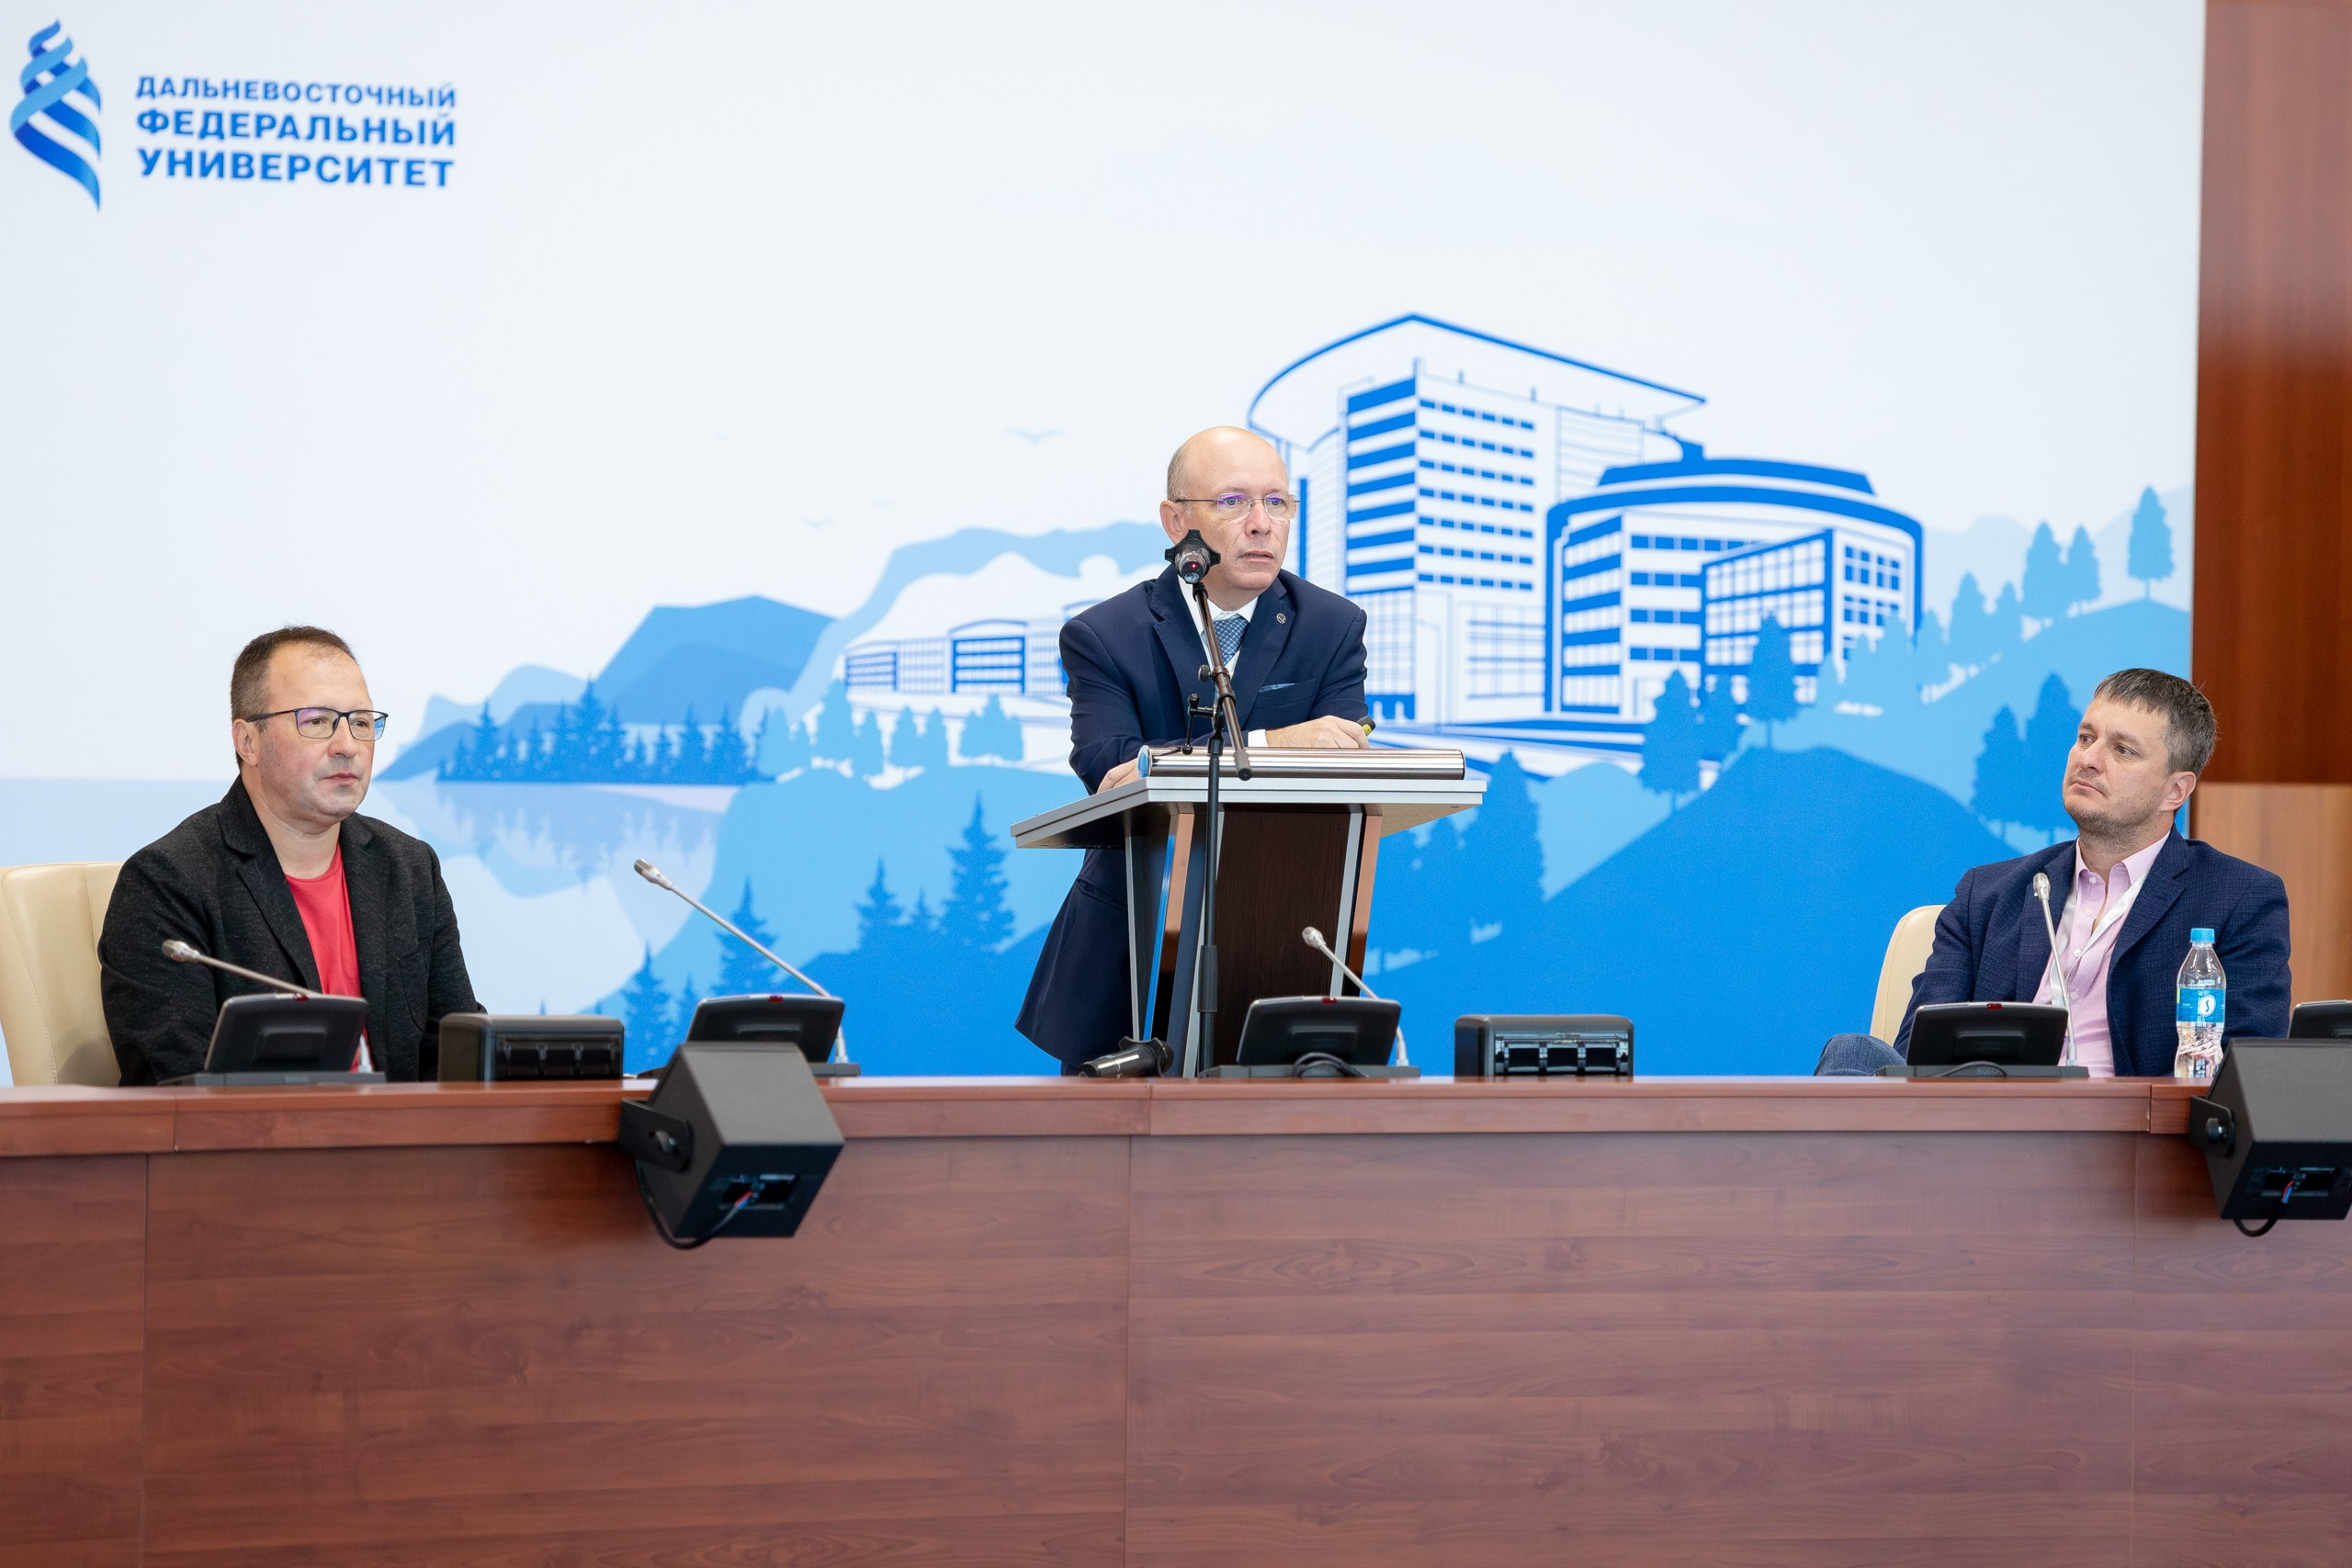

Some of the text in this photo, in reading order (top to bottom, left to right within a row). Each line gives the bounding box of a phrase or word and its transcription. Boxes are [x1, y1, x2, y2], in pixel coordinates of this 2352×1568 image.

[136, 75, 456, 108] ДАЛЬНЕВОСТОЧНЫЙ
[136, 107, 456, 147] ФЕДЕРАЛЬНЫЙ
[137, 147, 455, 188] УНИВЕРСИТЕТ
